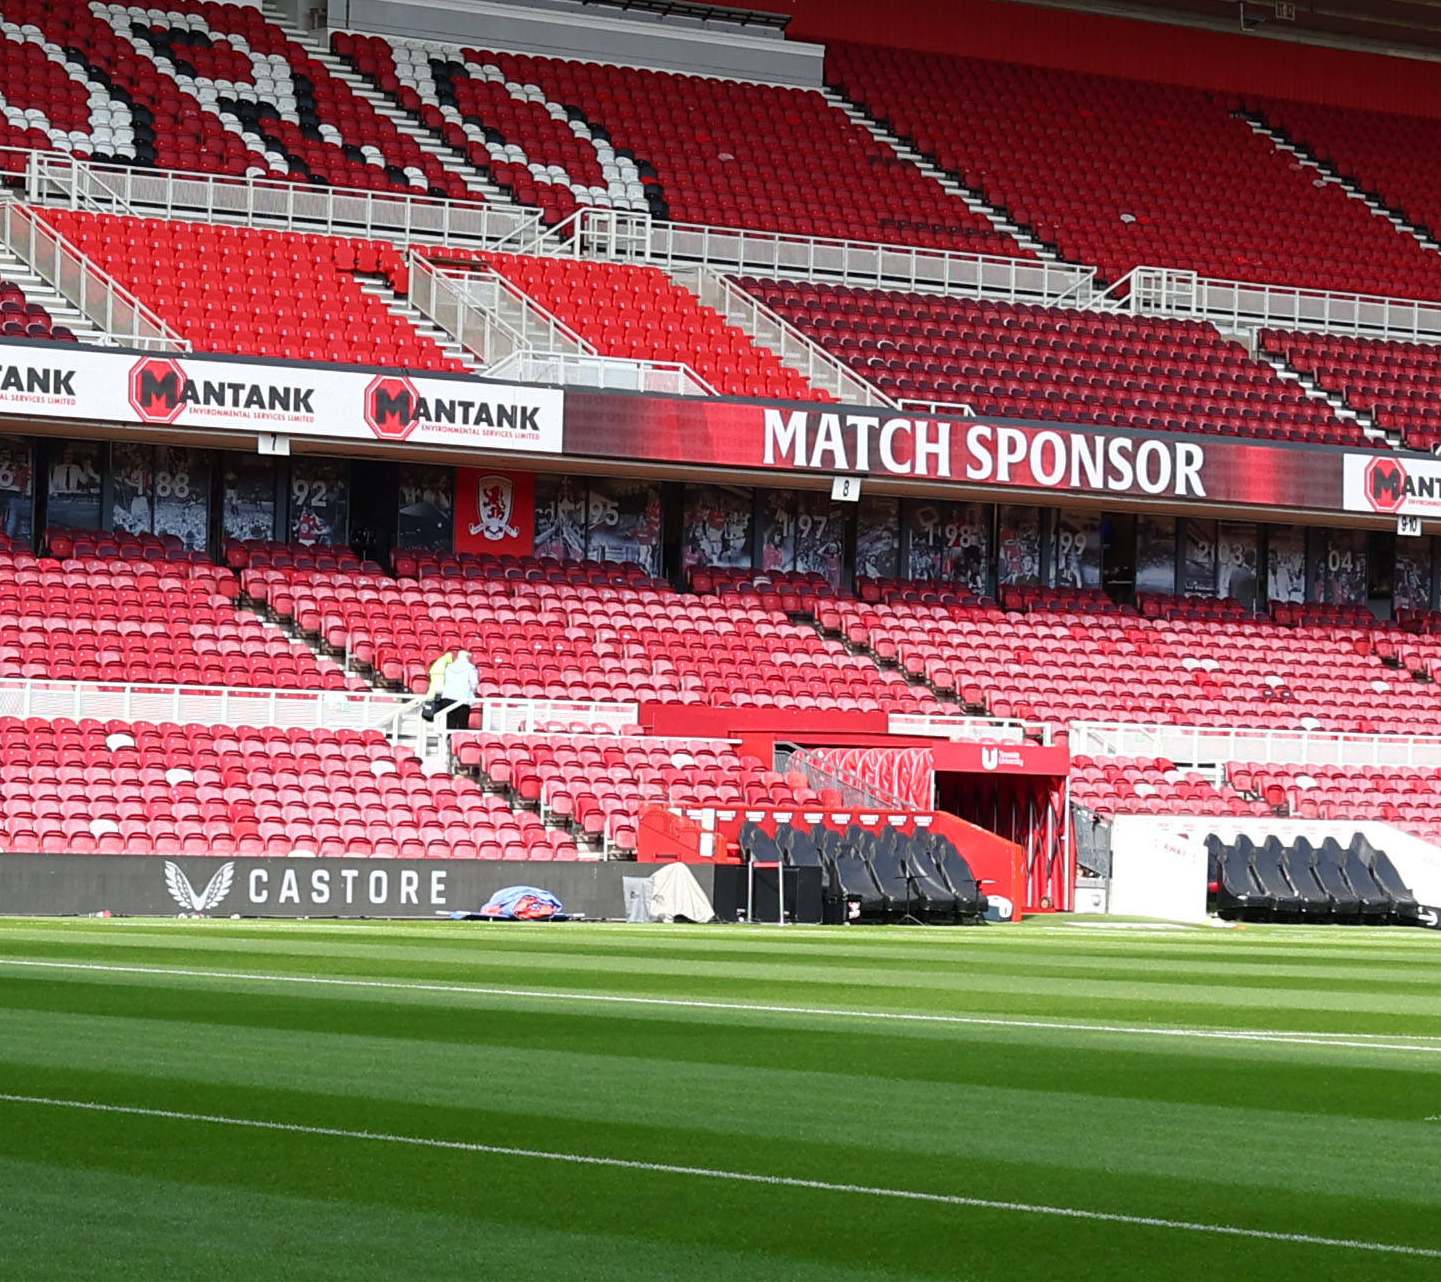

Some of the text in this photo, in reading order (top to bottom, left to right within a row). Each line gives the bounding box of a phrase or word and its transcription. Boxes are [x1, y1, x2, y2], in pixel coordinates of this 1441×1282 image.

[141, 369, 316, 414] MANTANK
[377, 388, 540, 431] MANTANK
[763, 409, 1207, 498] MATCH SPONSOR
[842, 479, 850, 497] 8
[248, 868, 448, 905] CASTORE
